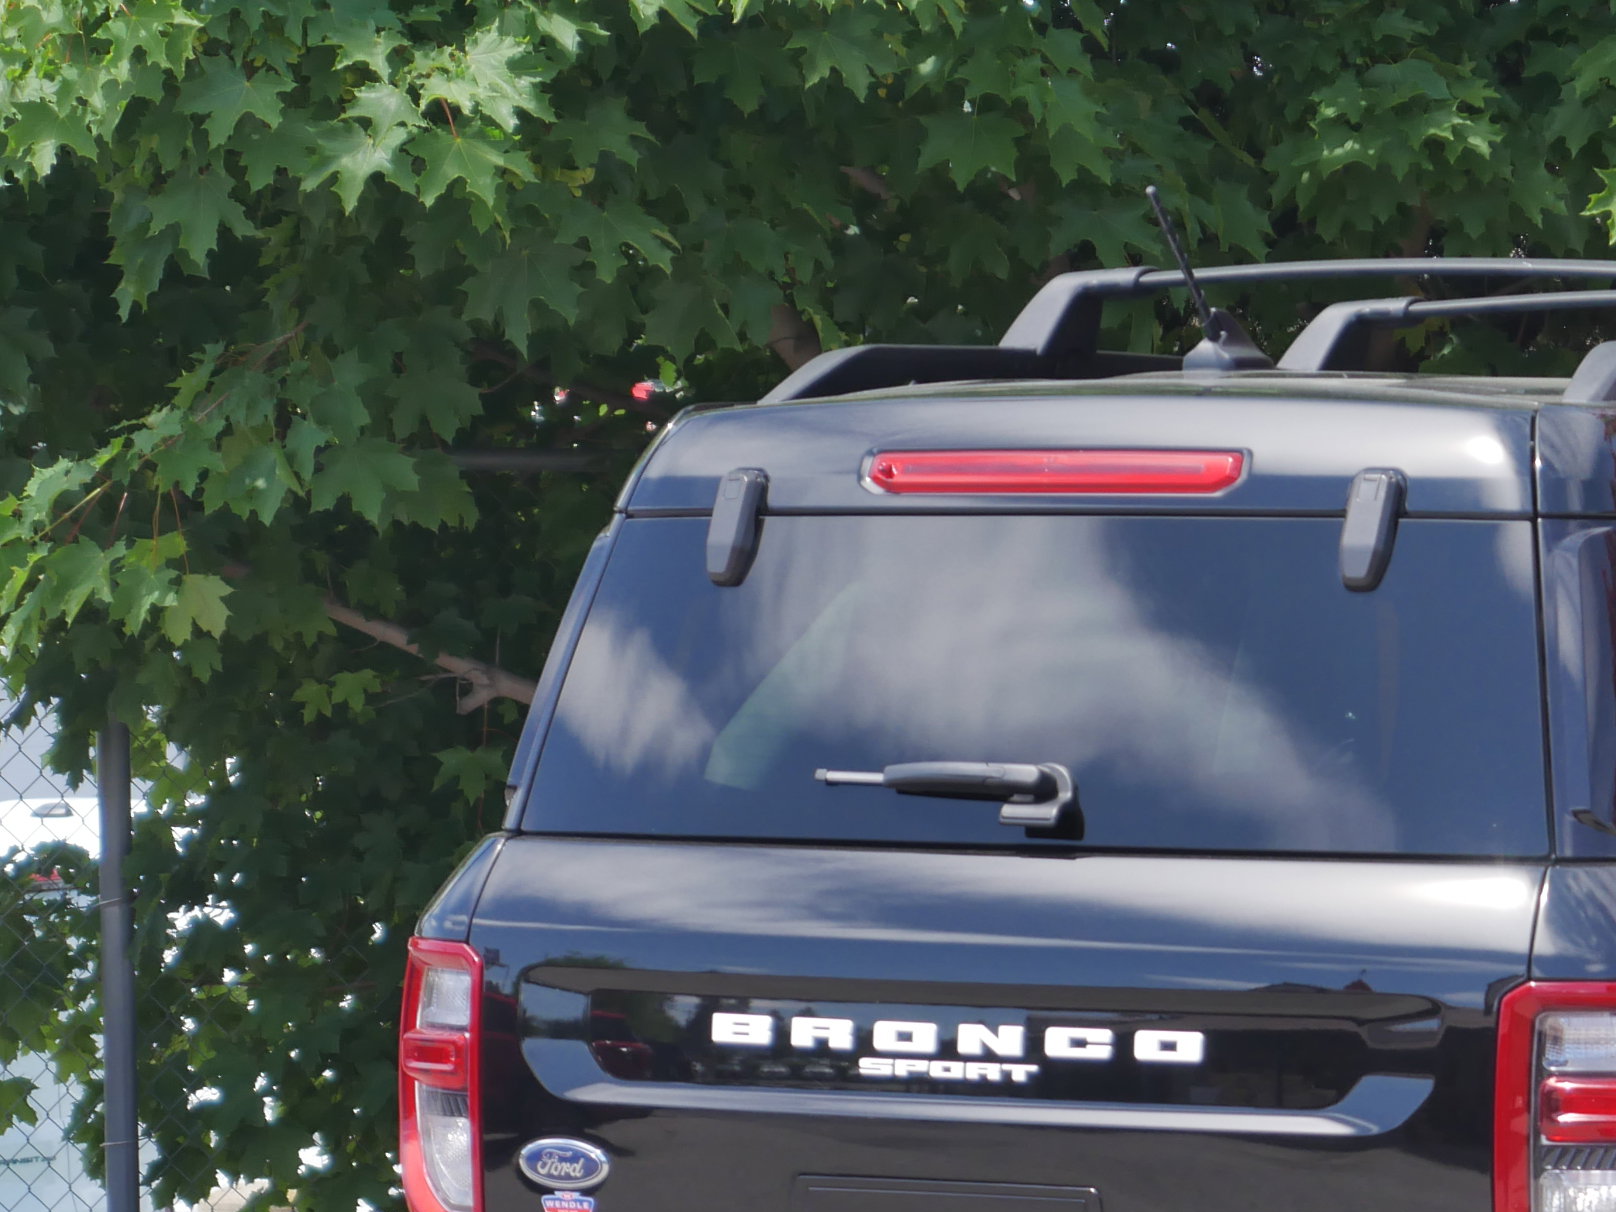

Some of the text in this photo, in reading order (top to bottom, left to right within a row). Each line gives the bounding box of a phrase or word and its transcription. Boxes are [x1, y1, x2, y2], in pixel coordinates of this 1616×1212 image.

[711, 1011, 1205, 1063] BRONCO
[857, 1056, 1039, 1083] SPORT
[537, 1148, 584, 1177] Ford
[545, 1200, 589, 1209] WENDLE
